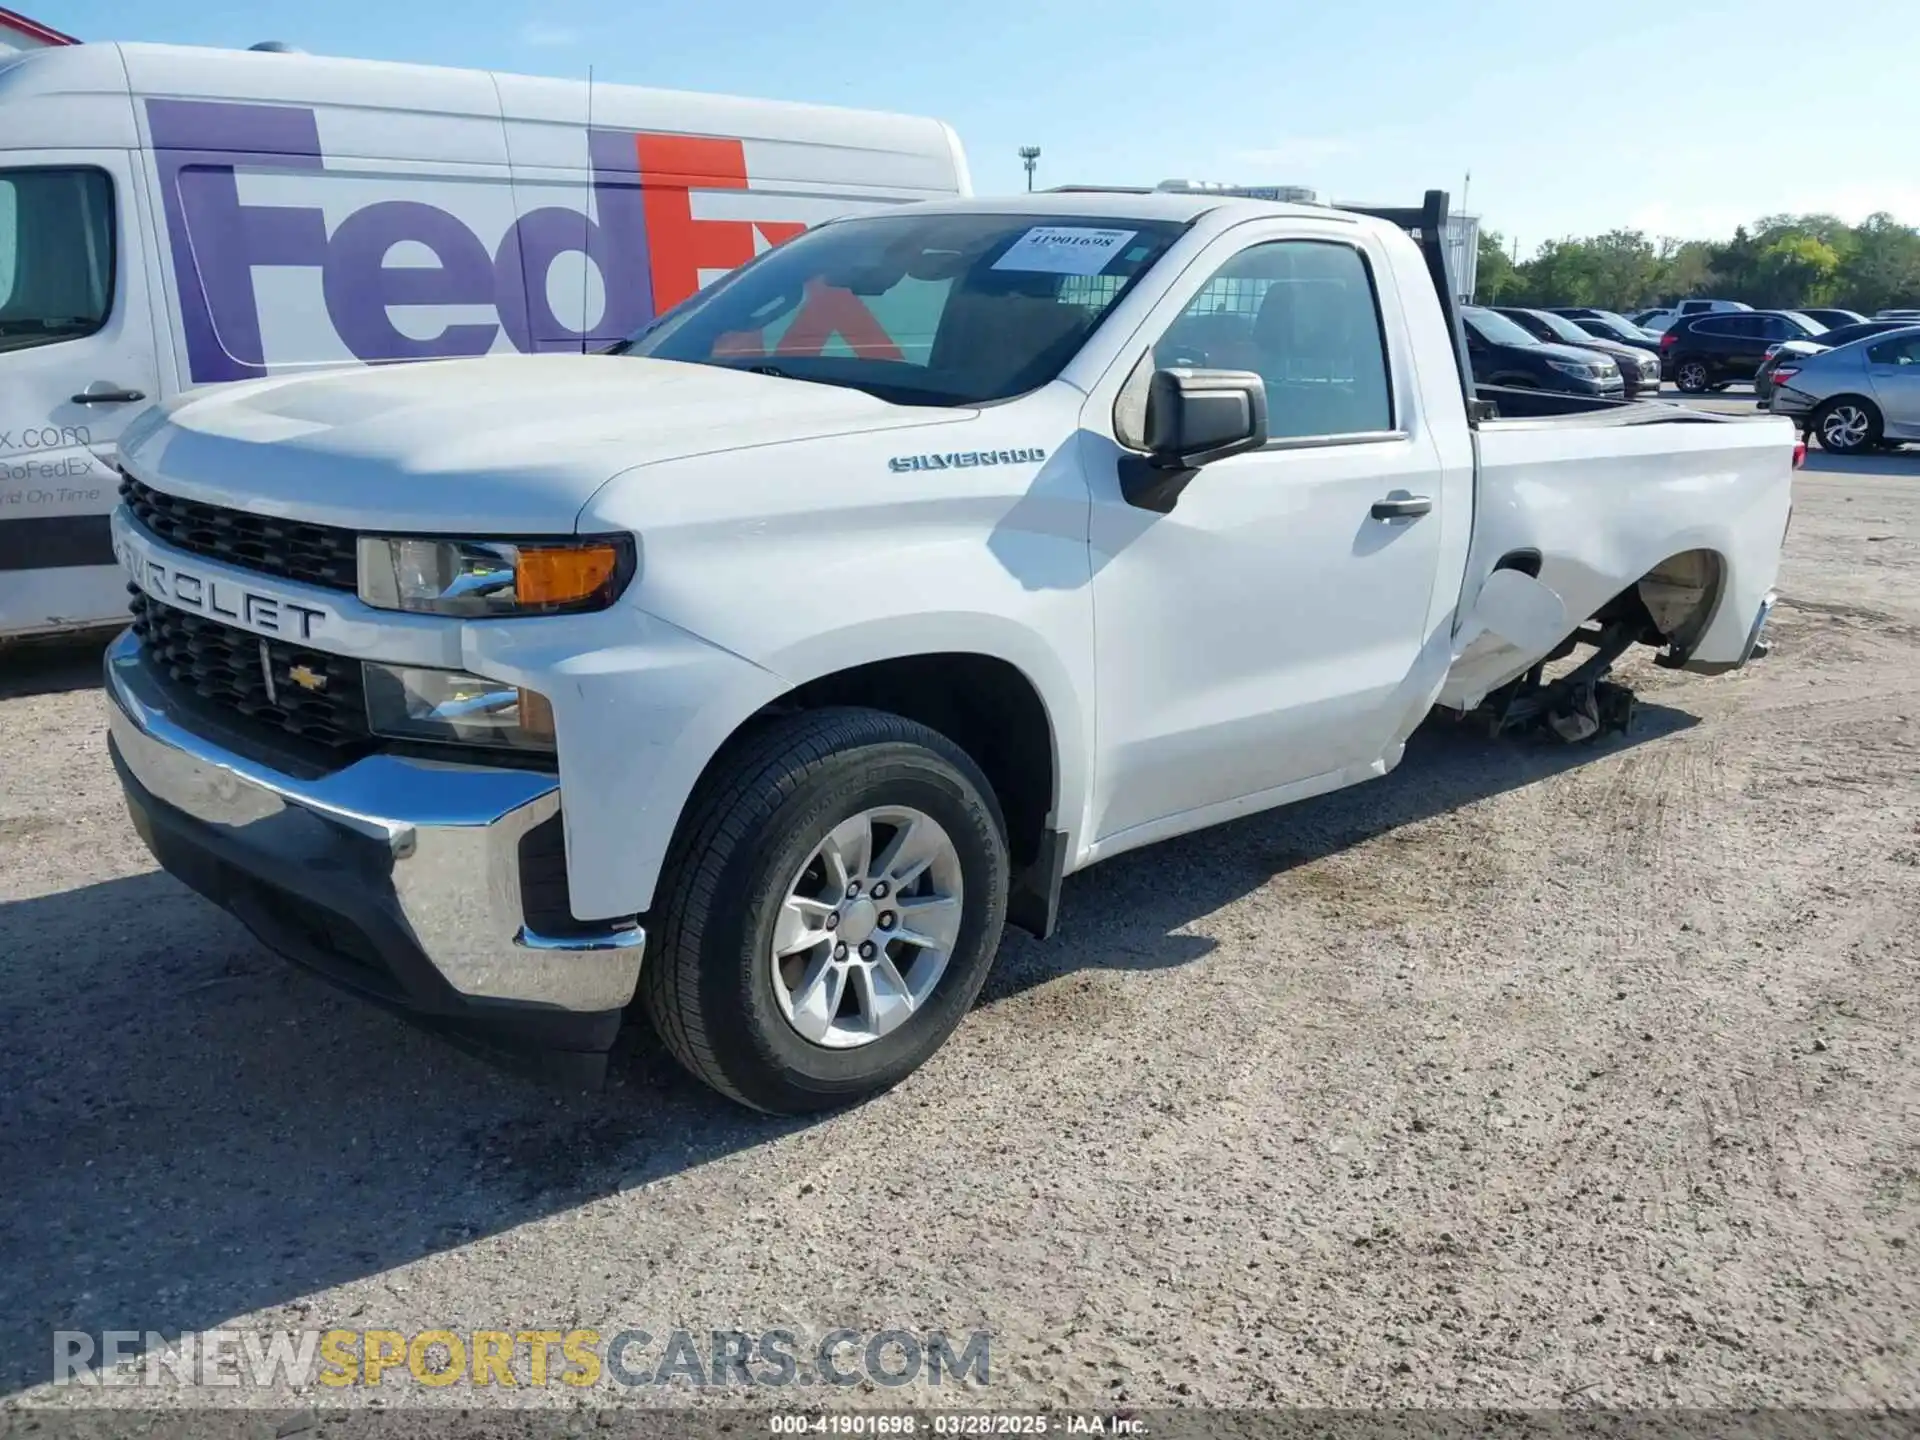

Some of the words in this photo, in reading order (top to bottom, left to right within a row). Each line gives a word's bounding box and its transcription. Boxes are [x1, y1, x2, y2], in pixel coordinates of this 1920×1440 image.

[1028, 234, 1115, 247] 41901698
[0, 425, 91, 449] x.com
[57, 487, 100, 502] Time
[113, 532, 326, 639] EVROLET
